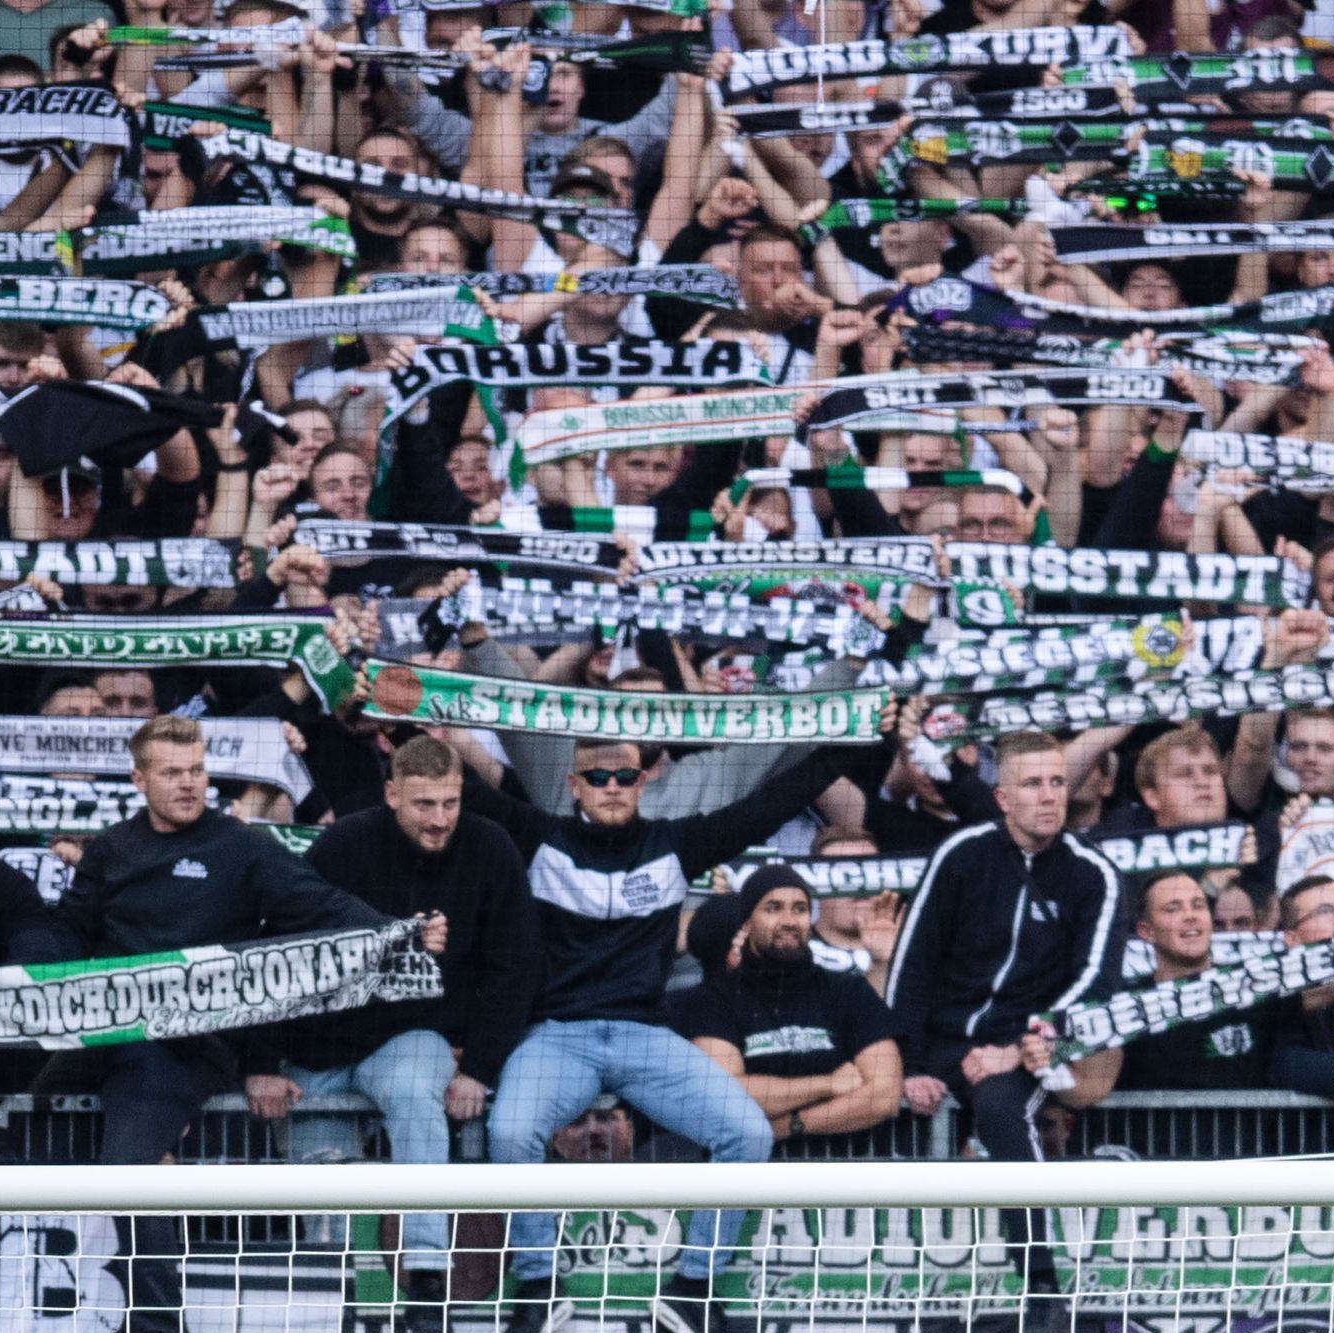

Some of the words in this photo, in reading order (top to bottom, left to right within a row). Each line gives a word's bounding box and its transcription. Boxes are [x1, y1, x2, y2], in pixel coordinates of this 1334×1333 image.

[391, 340, 742, 398] BORUSSIA
[520, 535, 601, 564] 1900
[948, 542, 1279, 603] TUSSTADT
[469, 682, 883, 740] STADIONVERBOT
[20, 979, 114, 1036] DICH
[117, 958, 243, 1023] DURCH
